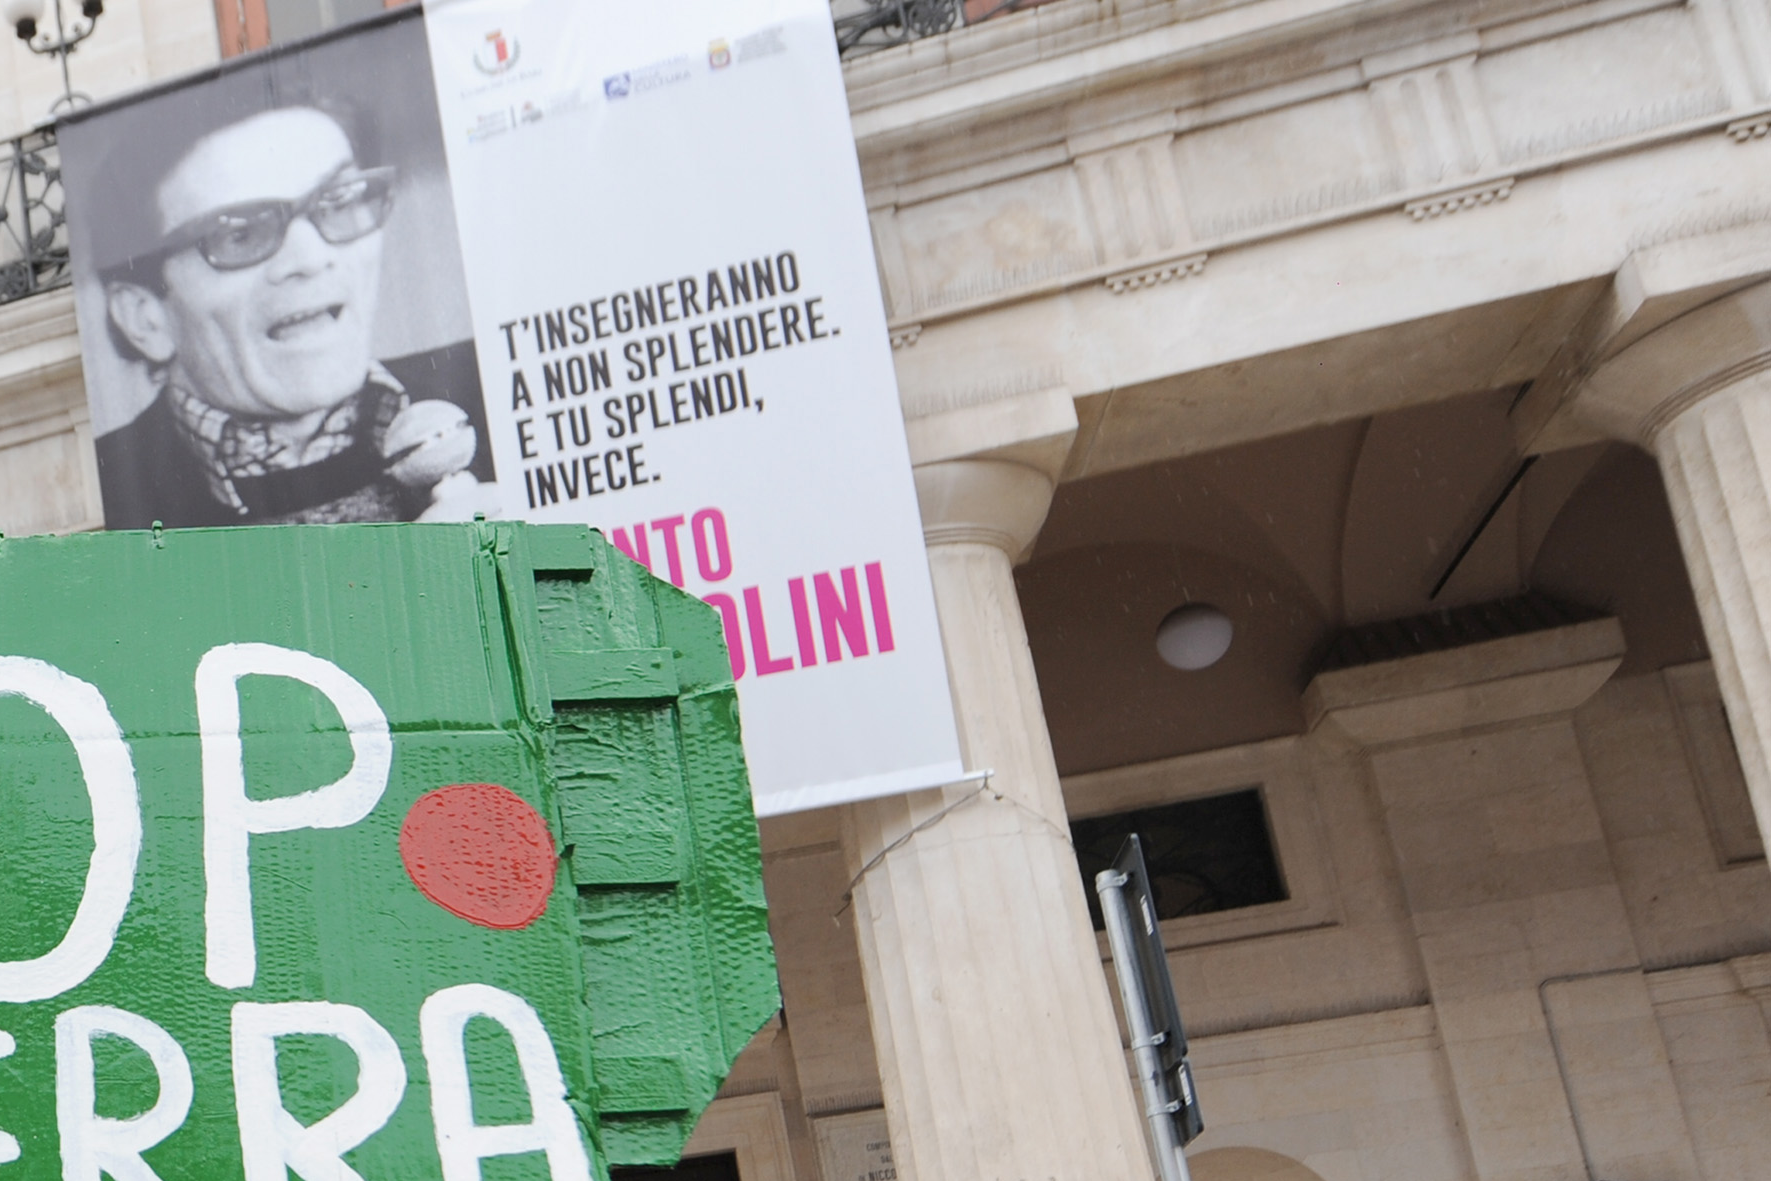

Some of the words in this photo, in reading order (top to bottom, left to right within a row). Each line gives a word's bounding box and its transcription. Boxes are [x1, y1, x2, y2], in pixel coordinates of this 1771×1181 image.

[499, 250, 801, 361] T'INSEGNERANNO
[512, 369, 534, 411] A
[542, 349, 612, 402] NON
[623, 297, 841, 382] SPLENDERE.
[516, 418, 539, 460] E
[546, 405, 592, 451] TU
[603, 367, 765, 439] SPLENDI,
[524, 443, 661, 510] INVECE.
[603, 507, 732, 588] NTO
